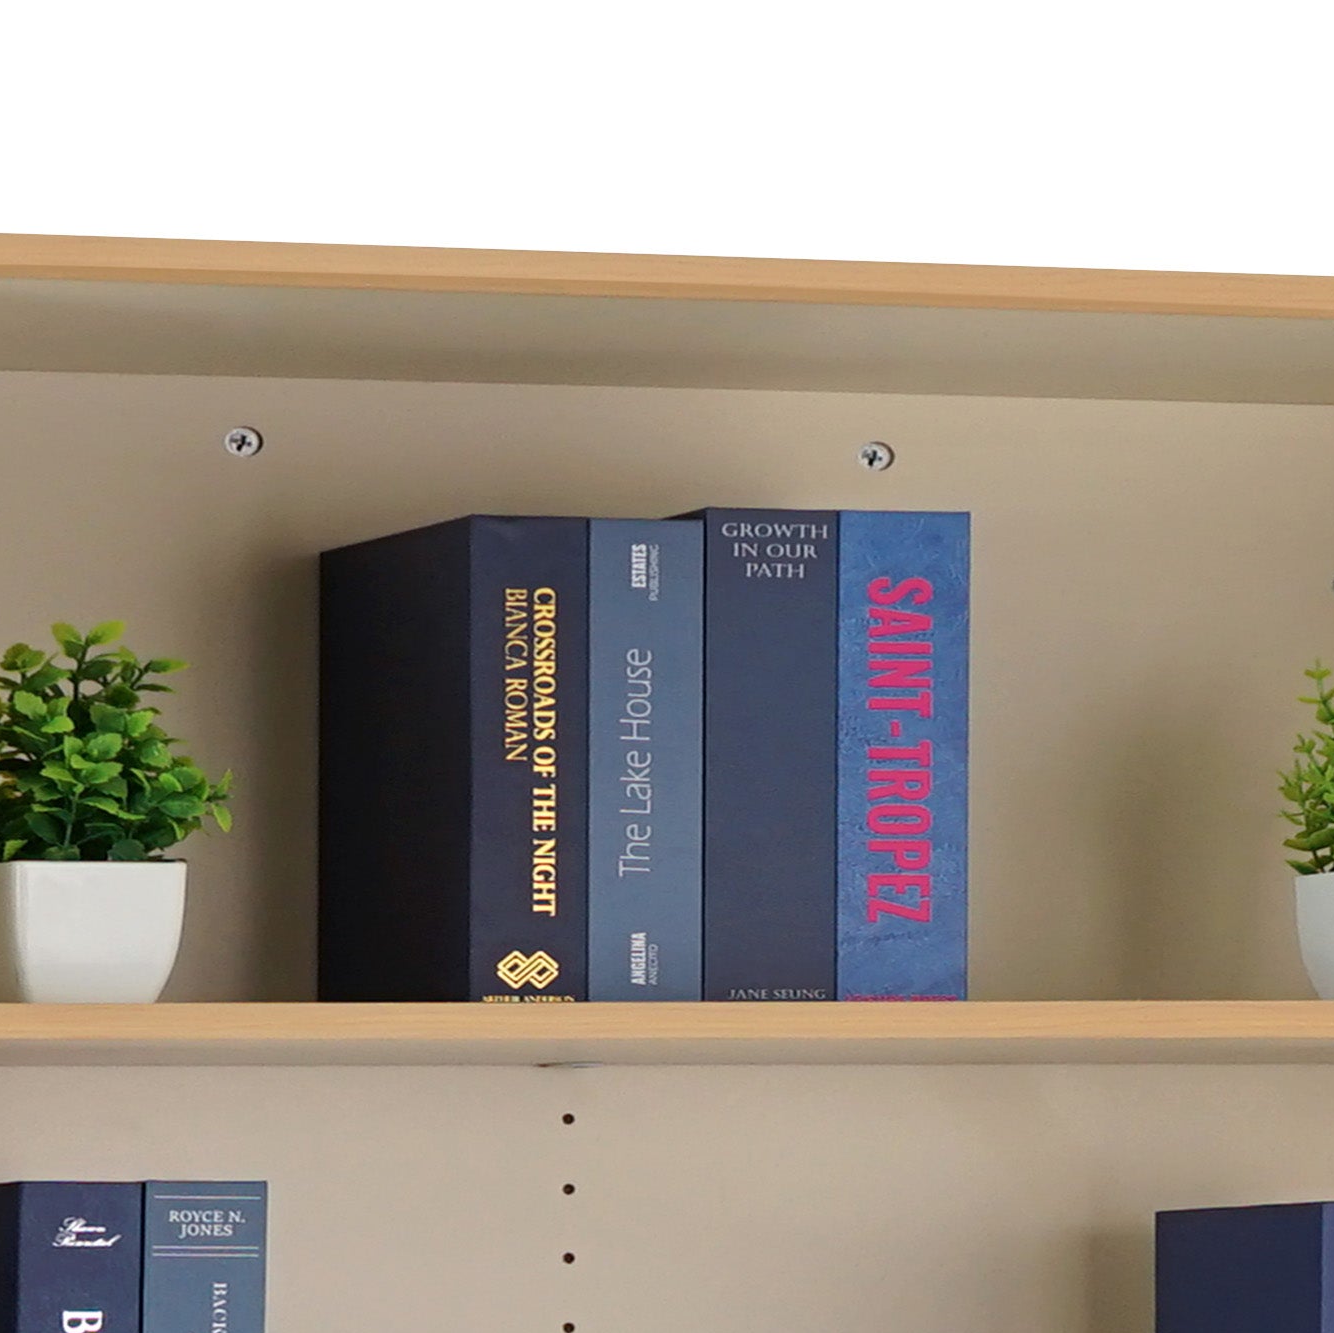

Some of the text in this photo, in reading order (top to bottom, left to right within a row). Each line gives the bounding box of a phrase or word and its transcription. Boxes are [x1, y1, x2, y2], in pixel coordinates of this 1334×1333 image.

[721, 523, 828, 539] GROWTH
[631, 543, 647, 587] ESTATES
[733, 543, 817, 558] IN OUR
[745, 562, 805, 578] PATH
[505, 588, 527, 761] BIANCA ROMAN
[533, 587, 556, 916] CROSSROADS OF THE NIGHT
[618, 648, 652, 877] The Lake House
[867, 577, 933, 923] SAINT-TROPEZ
[631, 932, 647, 985] ANGELINA
[727, 988, 768, 999] JANE
[169, 1210, 246, 1224] ROYCE N.
[179, 1225, 233, 1239] JONES
